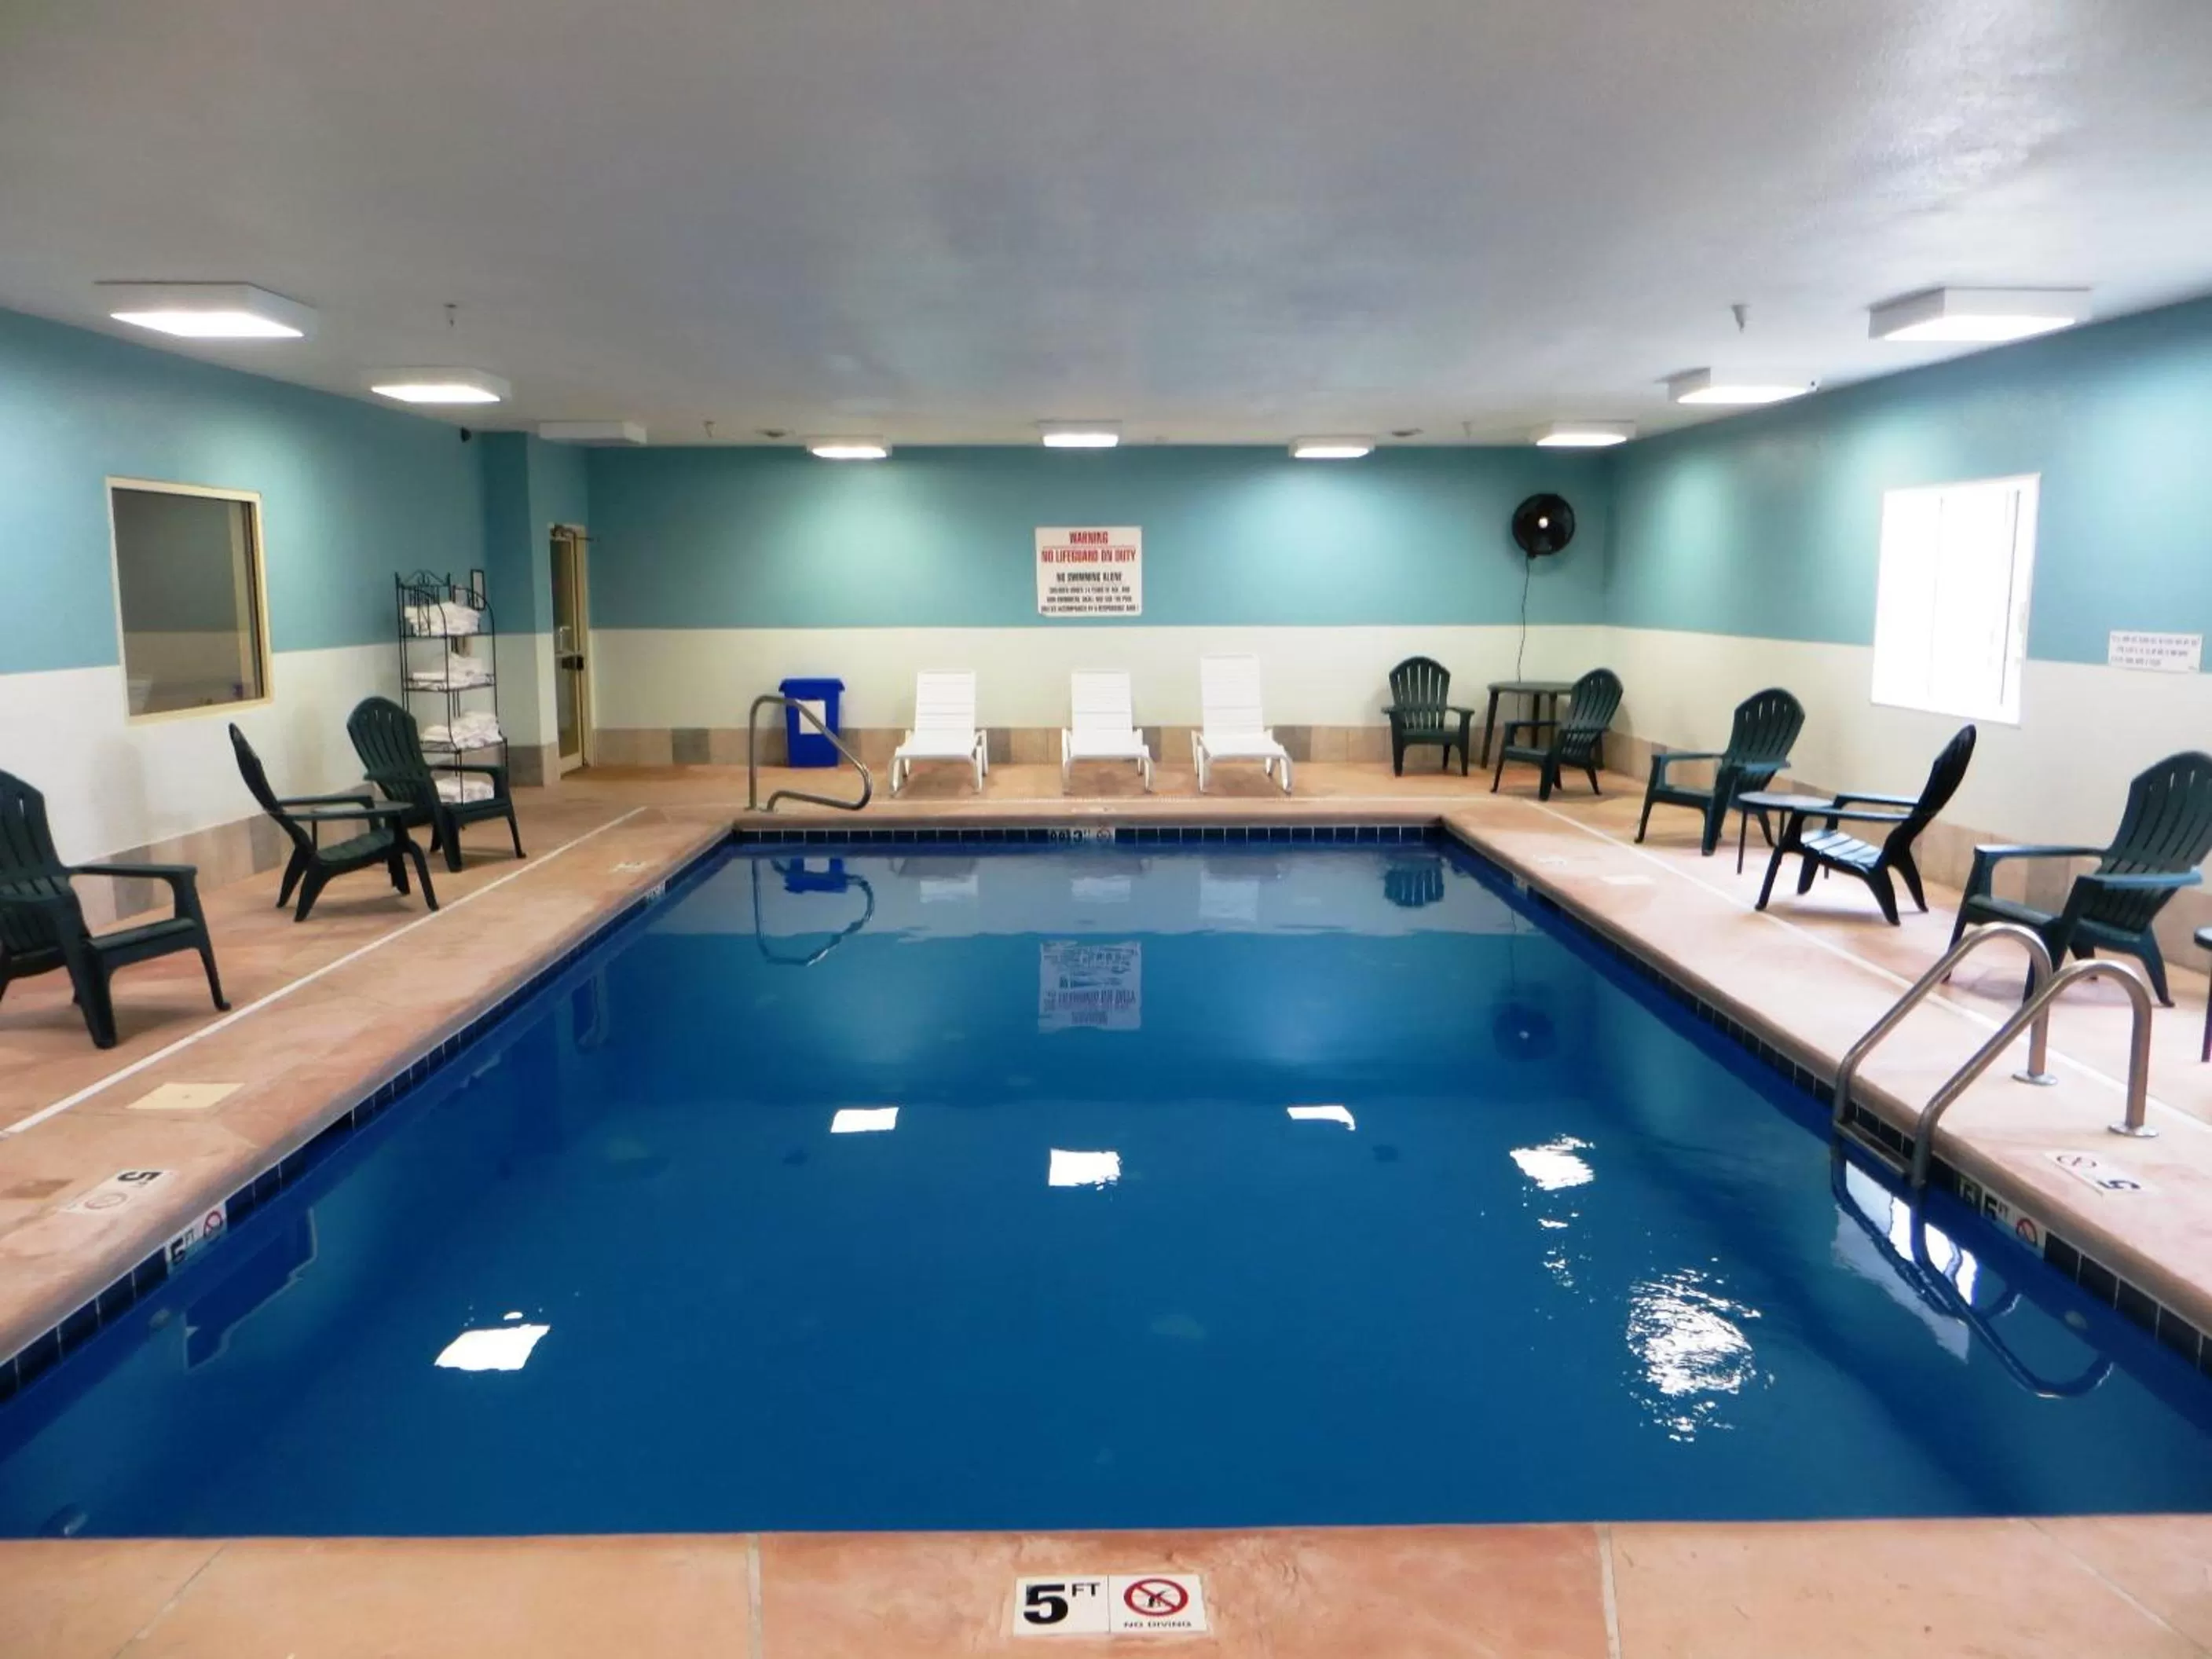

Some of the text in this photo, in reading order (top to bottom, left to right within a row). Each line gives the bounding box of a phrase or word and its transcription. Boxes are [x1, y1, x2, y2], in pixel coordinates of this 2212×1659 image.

[1069, 531, 1108, 544] WARNING
[1042, 548, 1136, 562] NO LIFEGUARD ON DUTY
[1068, 572, 1101, 582] SWIMMING
[117, 1171, 163, 1181] 5
[1024, 1583, 1100, 1625] 5 FT
